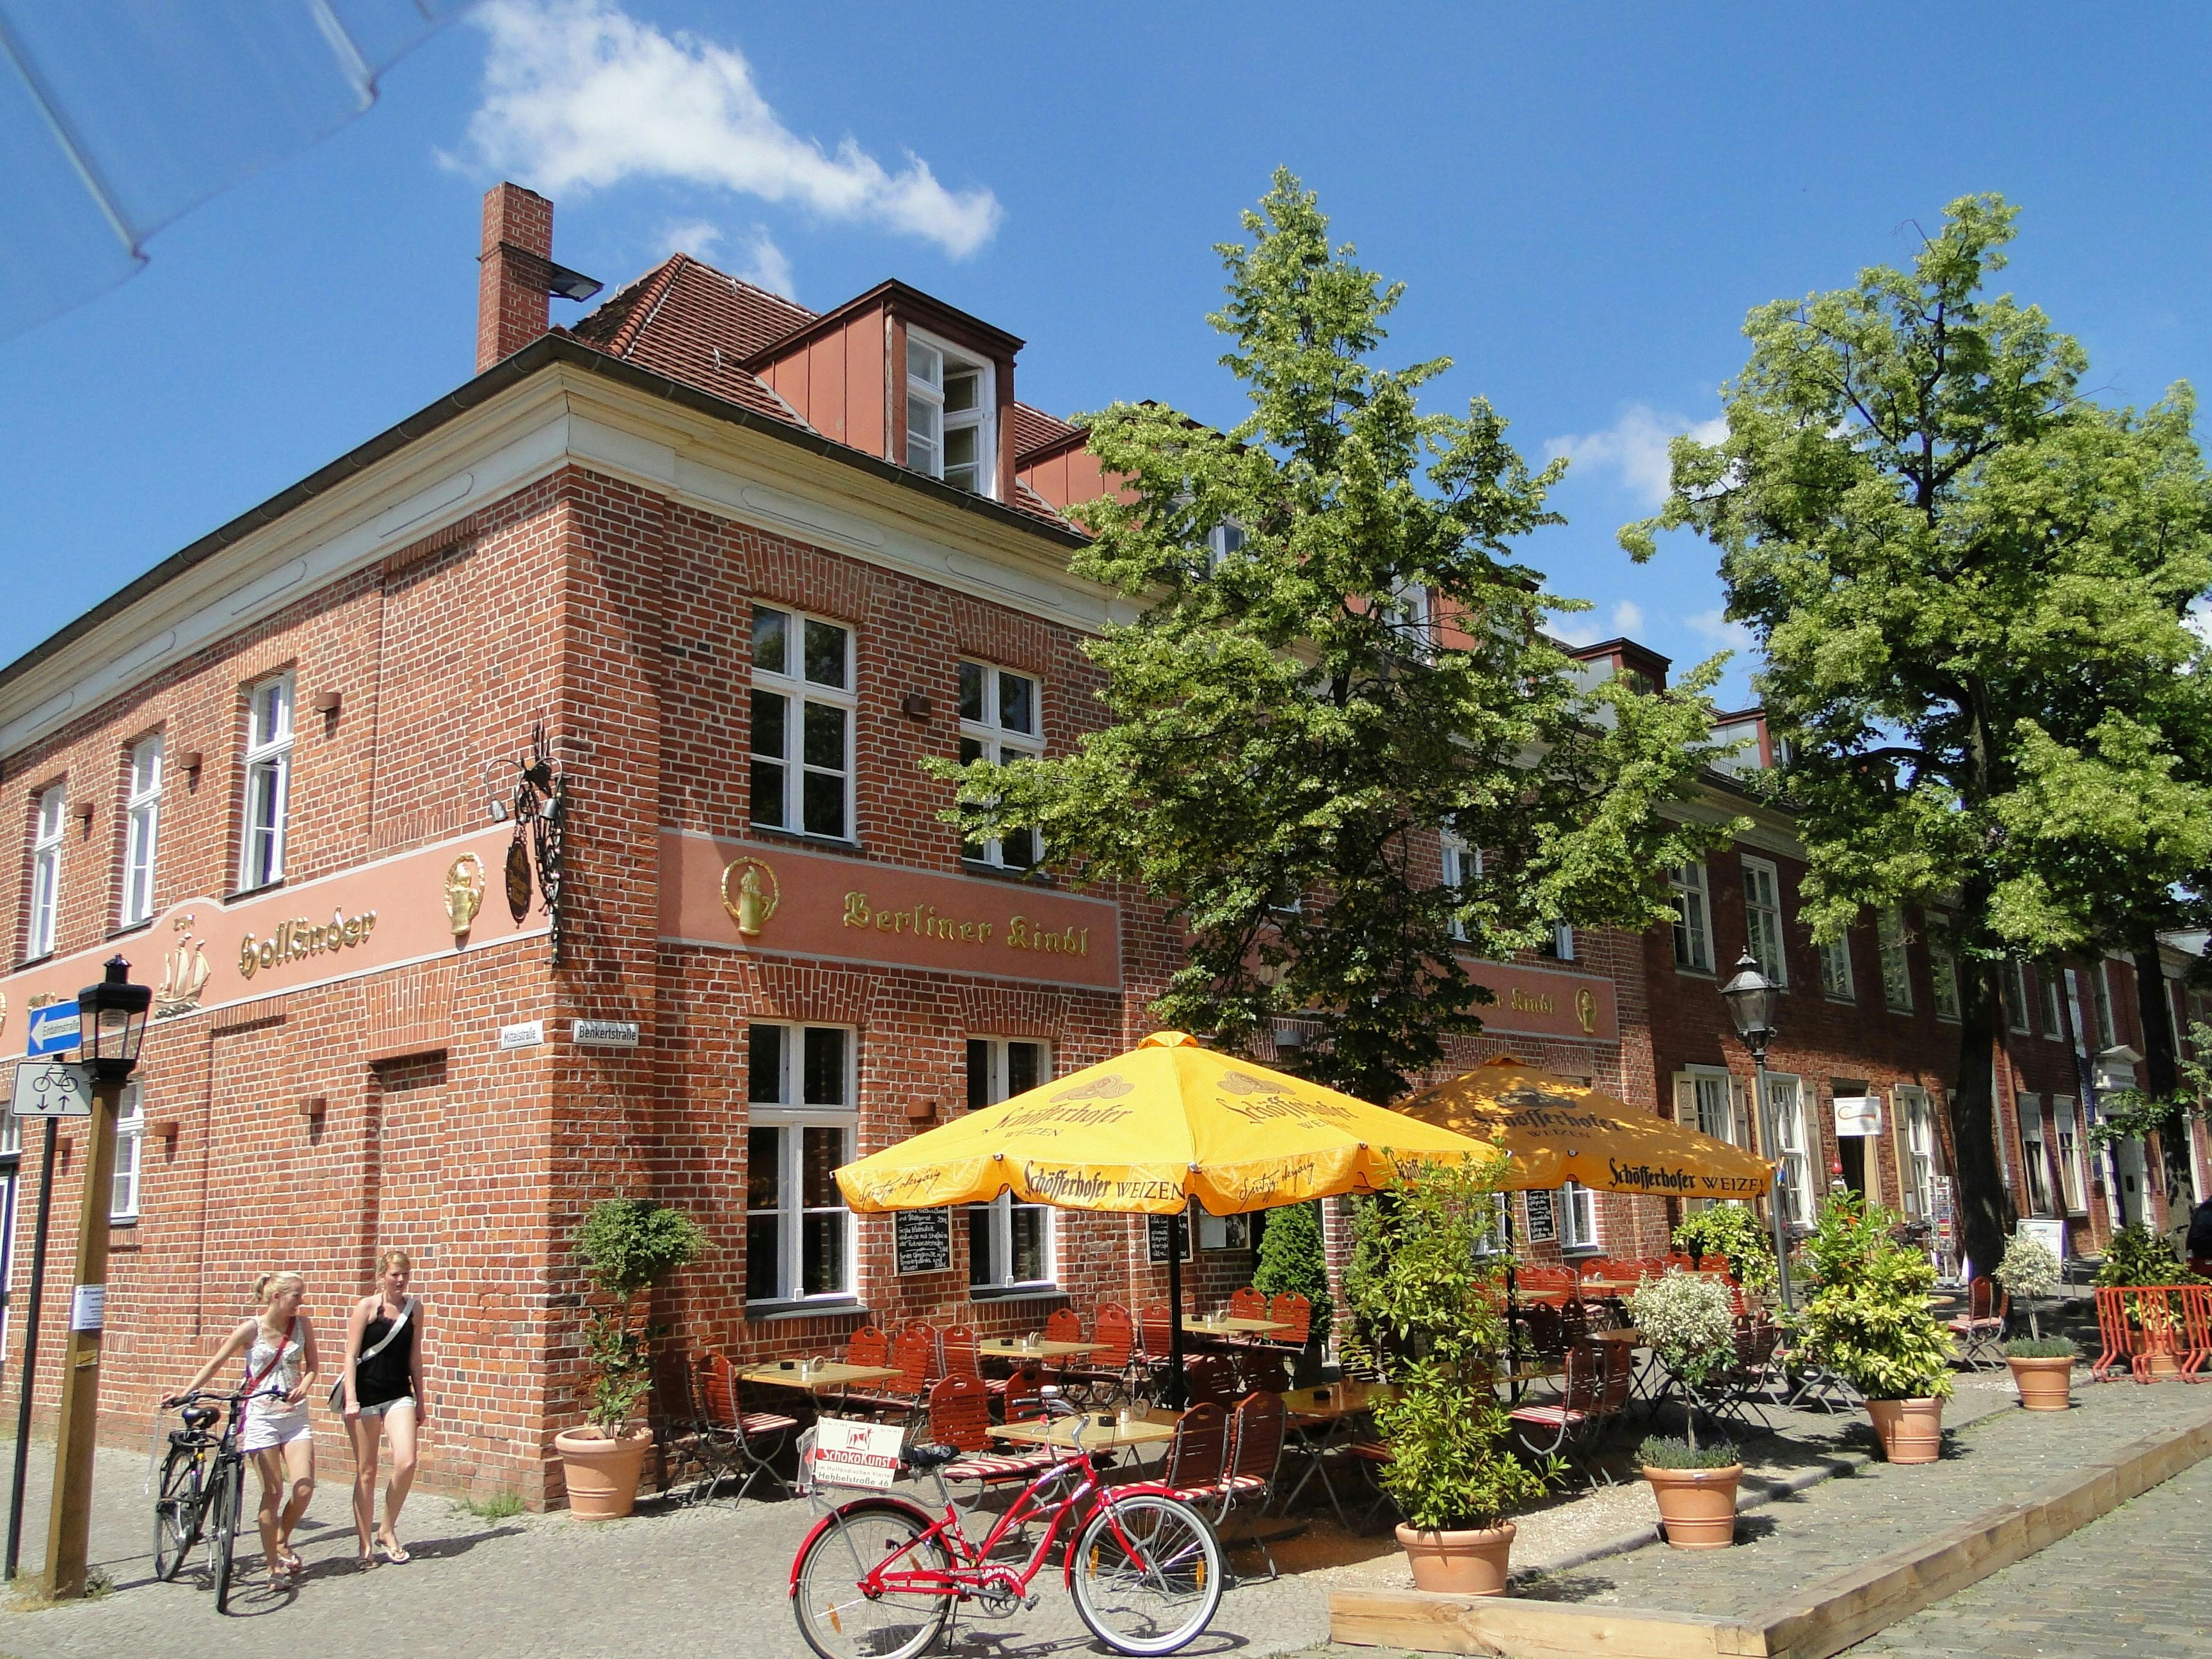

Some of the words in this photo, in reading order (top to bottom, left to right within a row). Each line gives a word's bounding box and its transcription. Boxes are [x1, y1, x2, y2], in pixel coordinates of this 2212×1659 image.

[843, 890, 994, 943] Berliner
[1007, 915, 1089, 956] Kindl
[239, 904, 378, 981] Holländer
[1511, 988, 1554, 1014] Kindl
[42, 1020, 79, 1037] Einbahnstraße
[504, 1027, 536, 1044] Mittelstraße
[579, 1025, 636, 1041] Benkertstraße
[981, 1102, 1134, 1135] Schöfferhofer
[1024, 1160, 1112, 1201] Schöfferhofer
[1117, 1181, 1186, 1201] WEIZEN
[1608, 1157, 1696, 1192] Schöfferhofer
[822, 1448, 892, 1468] SchokoKunst
[819, 1472, 876, 1486] Hebbelstraße
[827, 1464, 870, 1476] Holländischen
